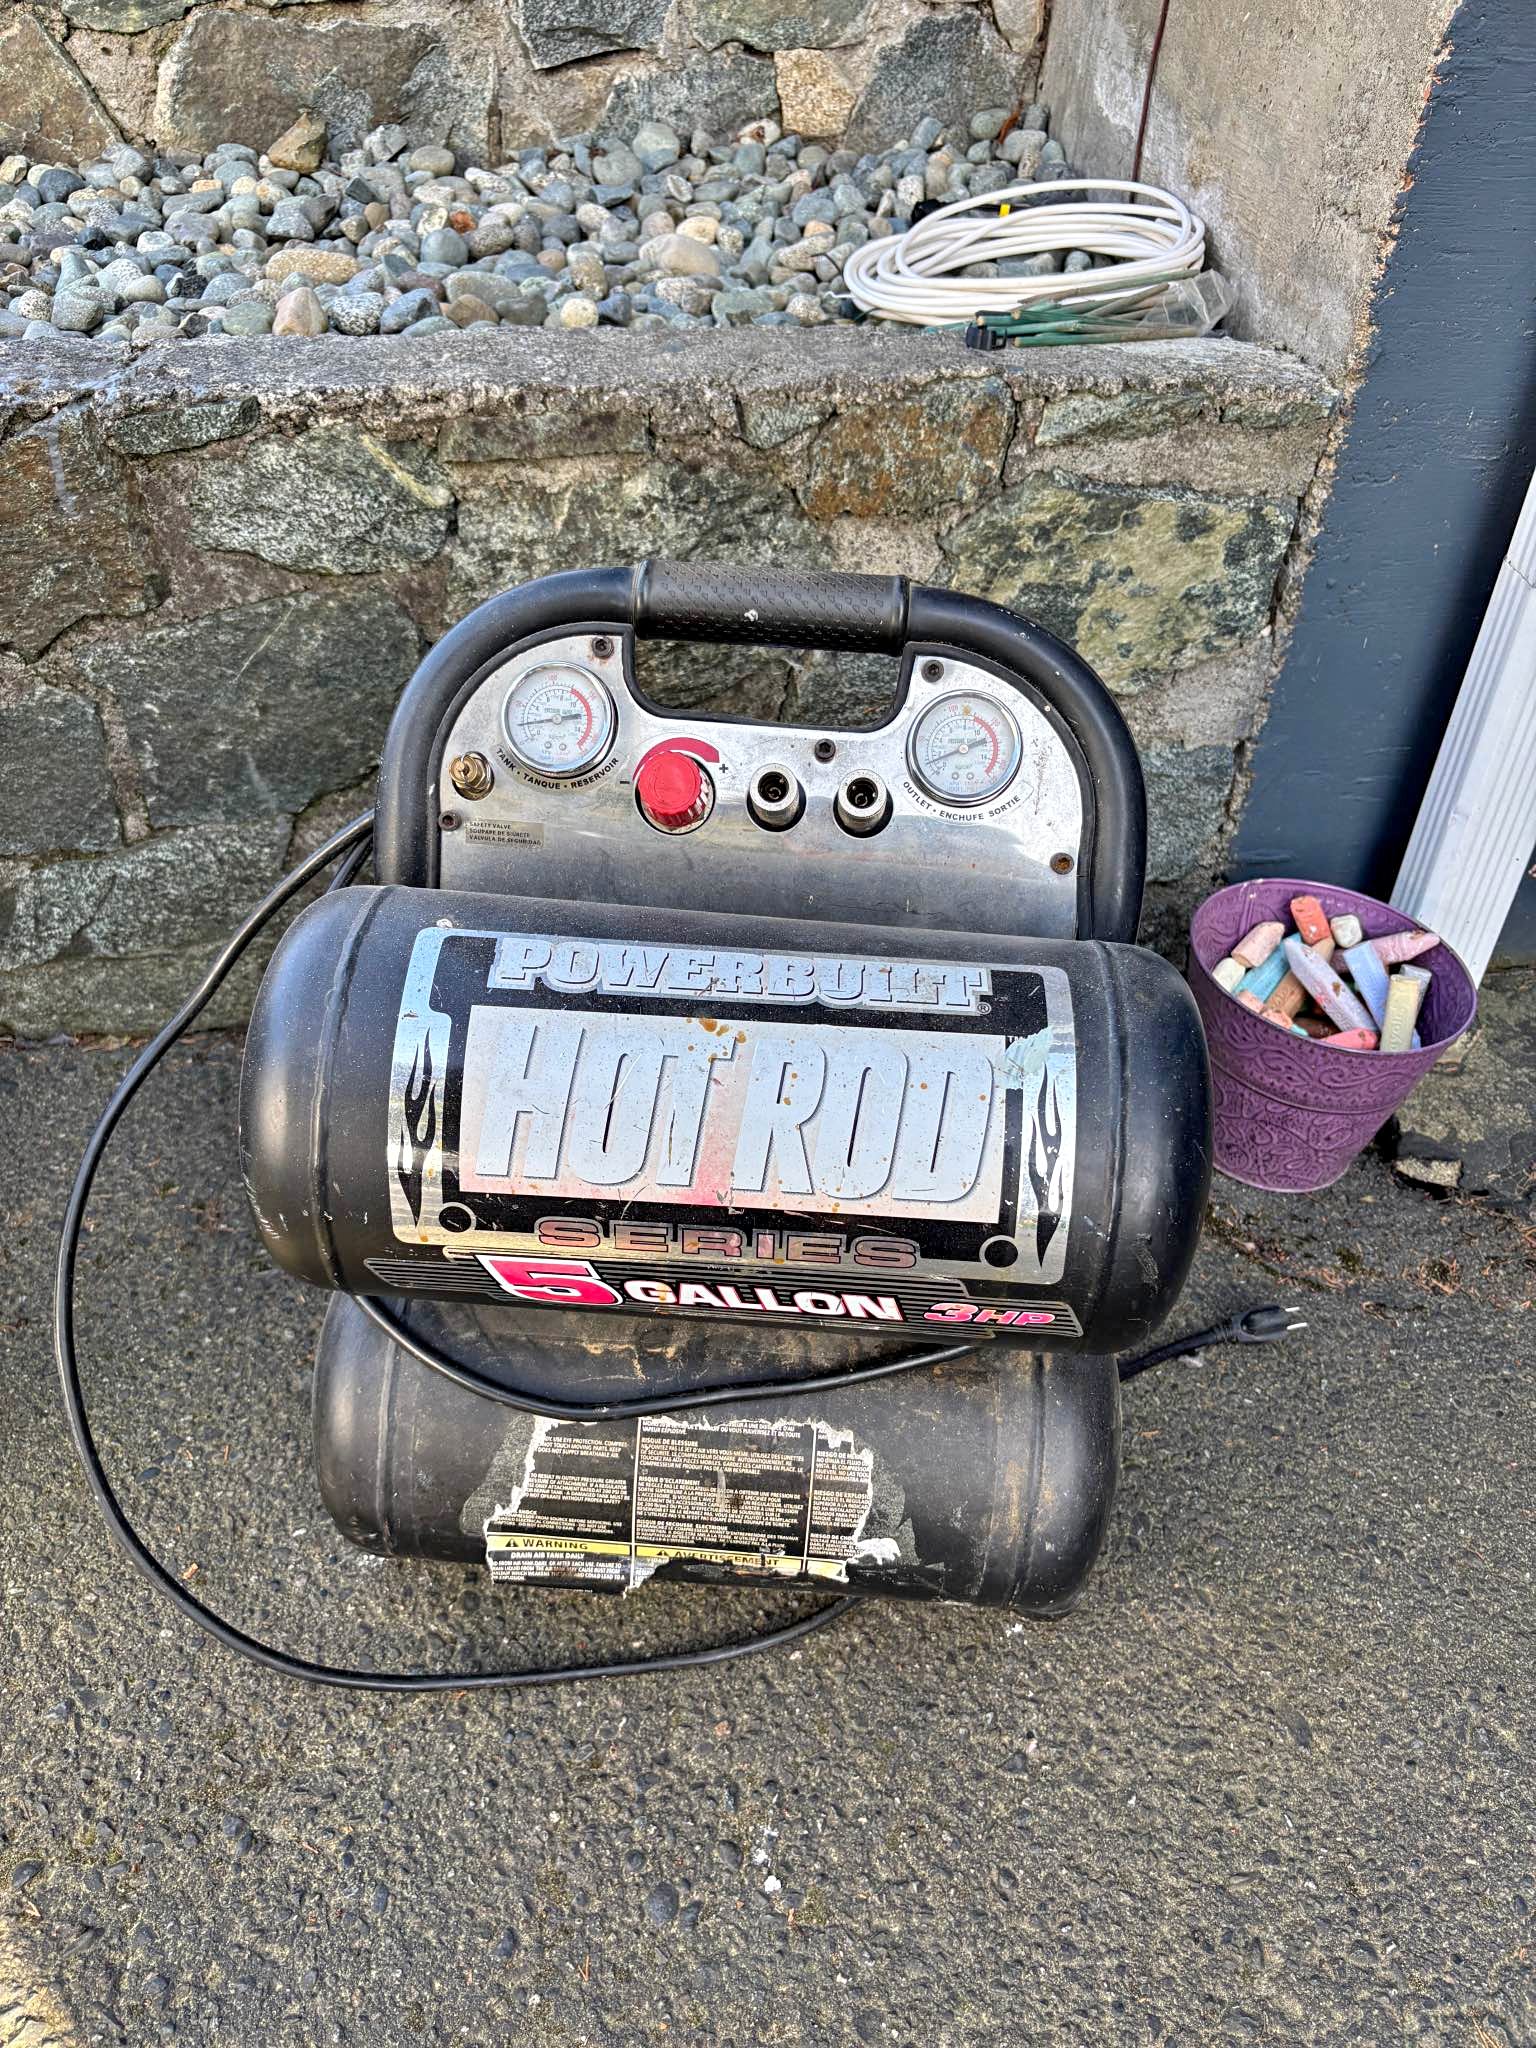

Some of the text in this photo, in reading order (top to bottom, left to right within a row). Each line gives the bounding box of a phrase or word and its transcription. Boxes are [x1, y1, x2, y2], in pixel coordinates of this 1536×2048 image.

[496, 749, 516, 772] TANK
[522, 773, 561, 790] TANQUE
[570, 757, 620, 789] RESERVOIR
[903, 781, 932, 810] OUTLET
[939, 810, 984, 822] ENCHUFE
[988, 795, 1021, 818] SORTIE
[499, 937, 989, 1008] POWERBUILT
[474, 1024, 995, 1203] HOT ROD
[538, 1218, 917, 1268] SERIES
[472, 1254, 1057, 1328] 5 GALLON 3HP
[523, 1538, 588, 1550] WARNING
